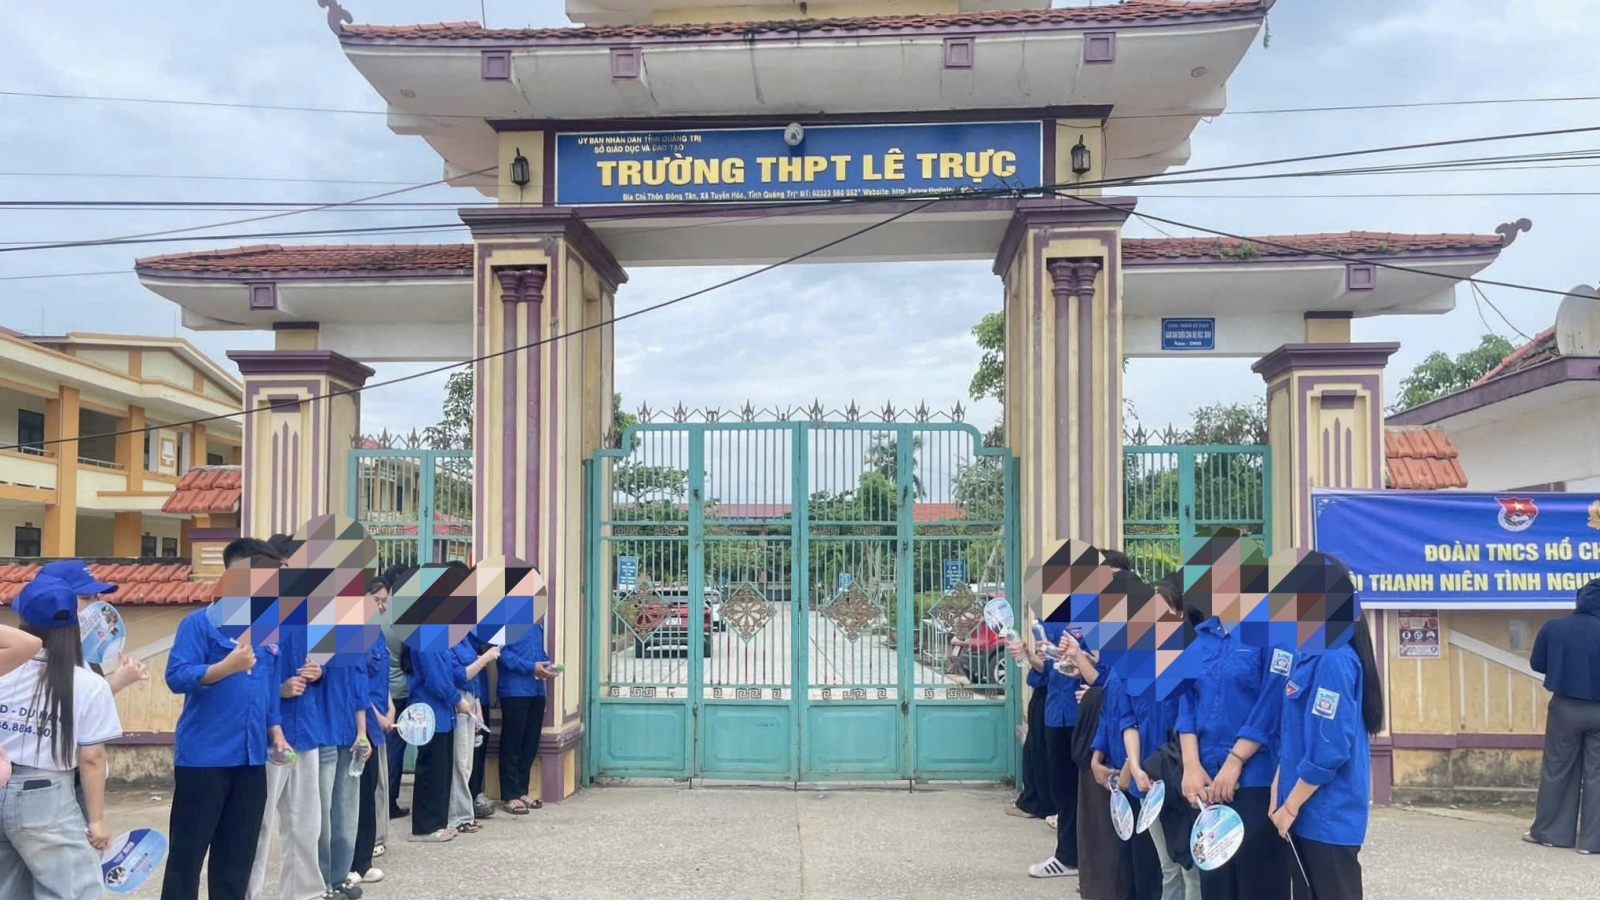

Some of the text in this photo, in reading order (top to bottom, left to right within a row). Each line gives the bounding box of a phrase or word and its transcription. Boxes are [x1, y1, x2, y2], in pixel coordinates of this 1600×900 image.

[597, 148, 1017, 187] TRƯỜNG THPT LÊ TRỰC
[1424, 540, 1480, 562] ĐOÀN
[1486, 542, 1539, 562] TNCS
[1369, 573, 1433, 592] THANH
[1440, 570, 1489, 591] NIÊN
[1494, 569, 1541, 591] TÌNH
